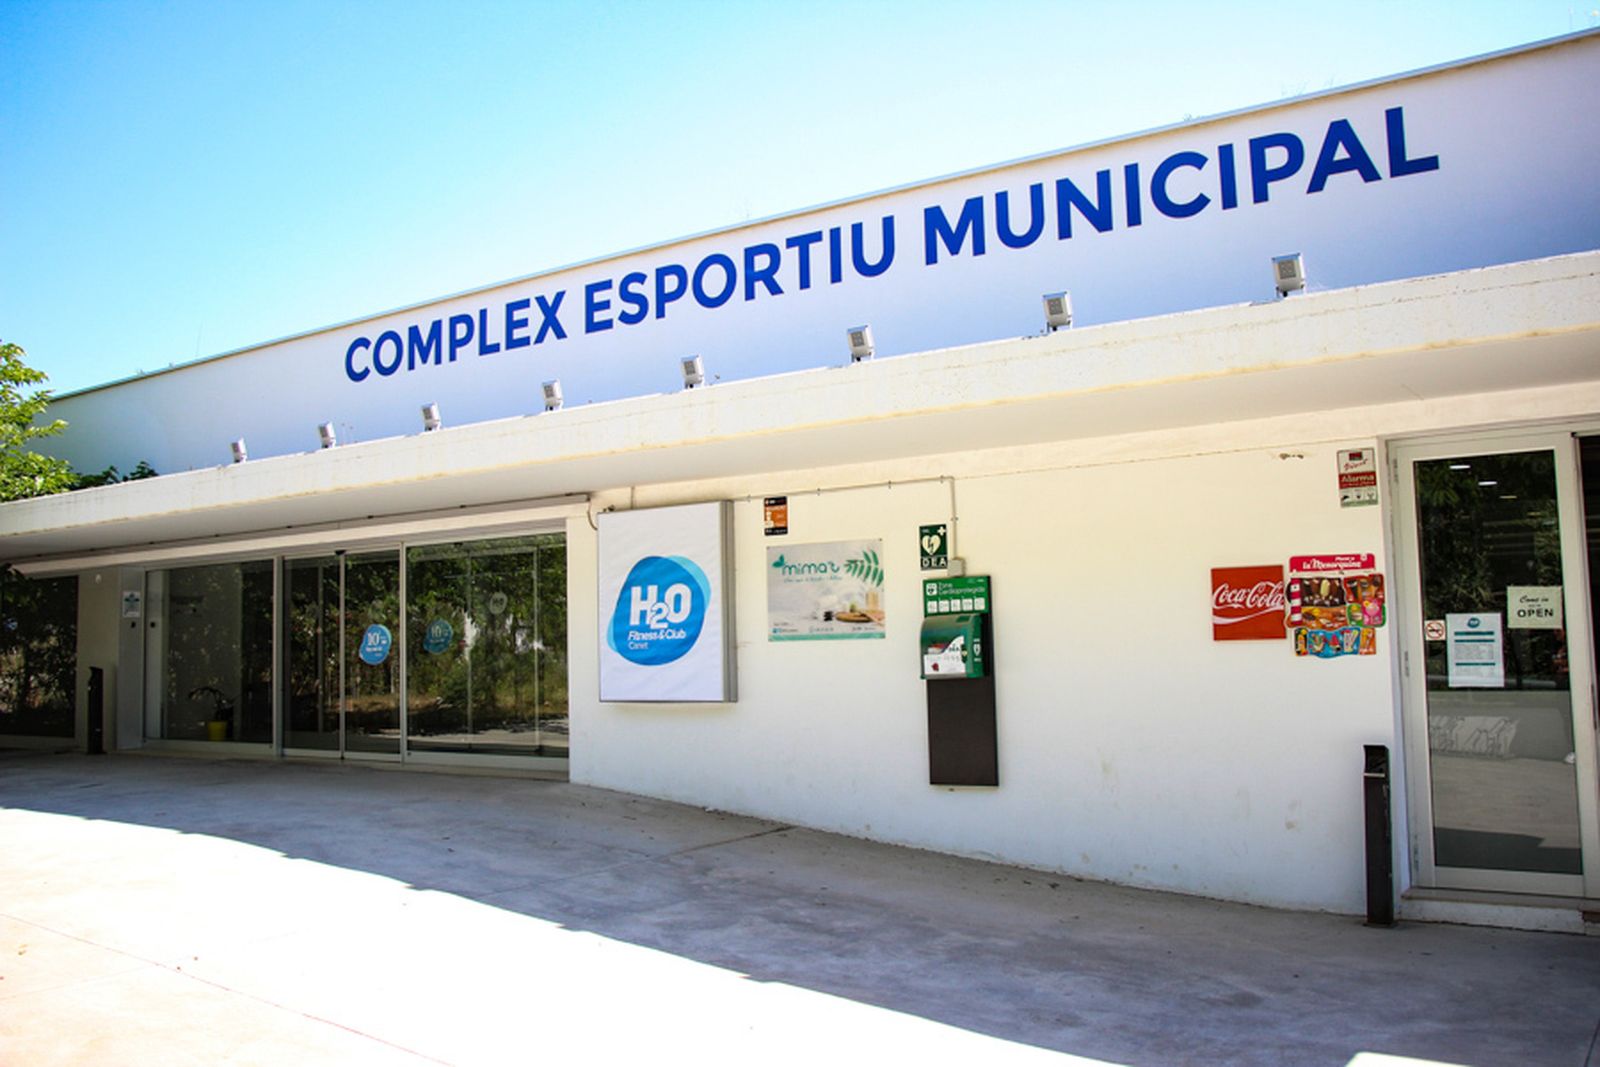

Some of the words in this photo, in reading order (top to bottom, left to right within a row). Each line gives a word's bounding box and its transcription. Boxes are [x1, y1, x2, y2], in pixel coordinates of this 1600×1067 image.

[345, 290, 568, 382] COMPLEX
[584, 215, 895, 334] ESPORTIU
[923, 106, 1440, 266] MUNICIPAL
[922, 557, 946, 567] DEA
[629, 583, 692, 629] H2O
[1212, 581, 1284, 609] Coca-Cola
[1517, 608, 1554, 618] OPEN
